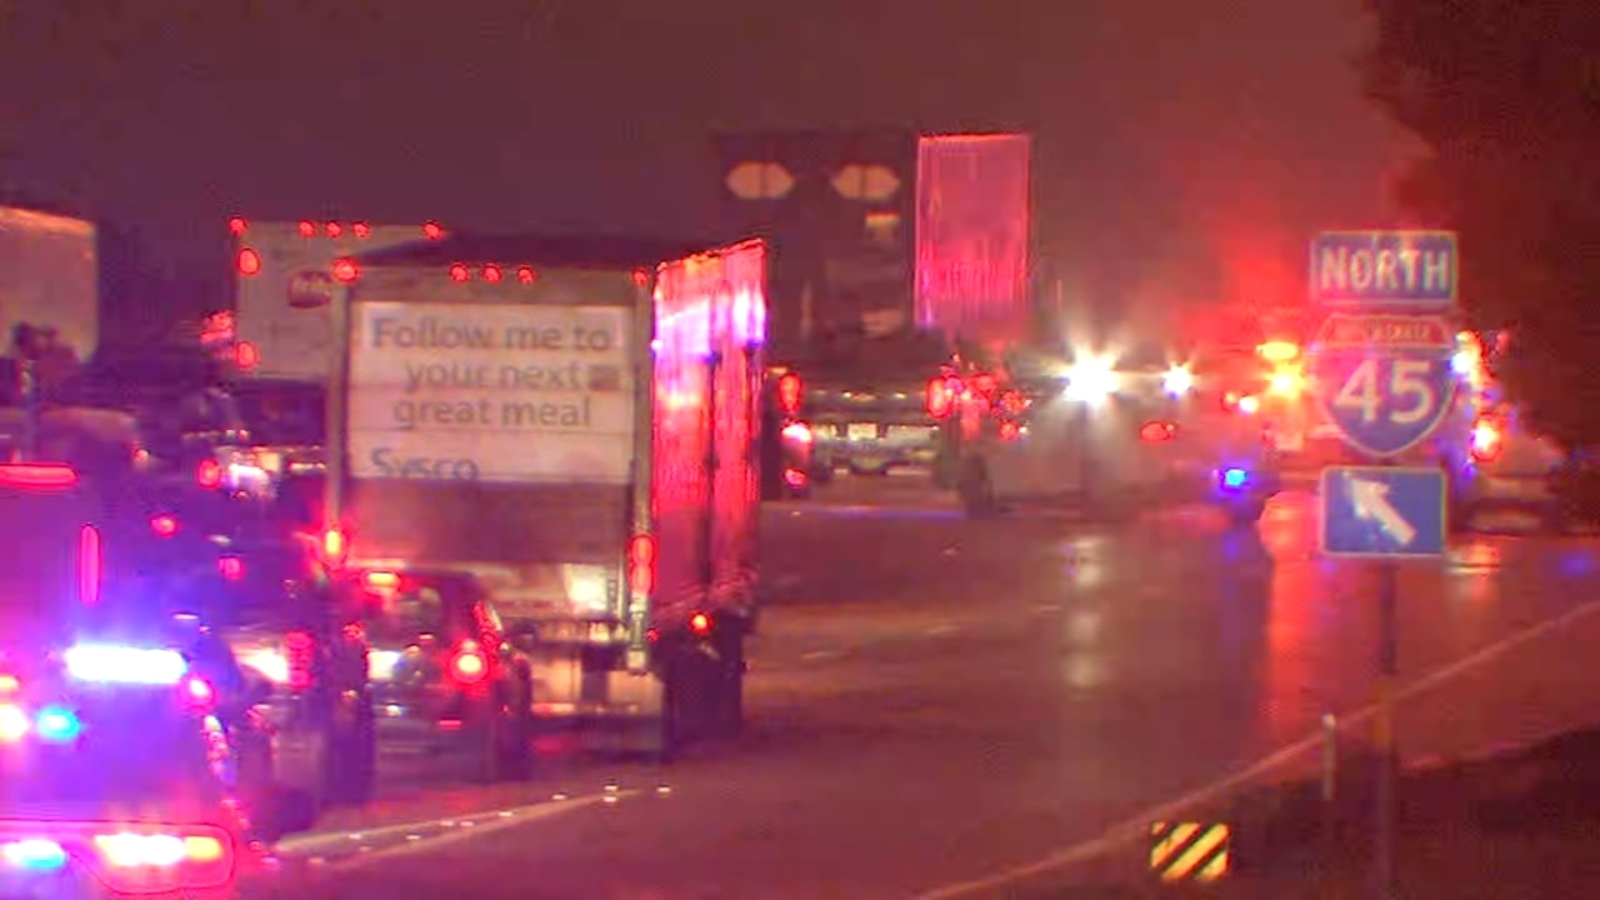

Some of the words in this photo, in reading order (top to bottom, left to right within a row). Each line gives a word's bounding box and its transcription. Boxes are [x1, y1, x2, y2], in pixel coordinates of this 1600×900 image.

[1320, 247, 1449, 291] NORTH
[371, 317, 493, 347] Follow
[505, 325, 560, 347] me
[573, 322, 611, 351] to
[404, 364, 492, 392] your
[500, 363, 581, 390] next
[1334, 359, 1434, 423] 45
[393, 399, 492, 430] great
[502, 397, 591, 426] meal
